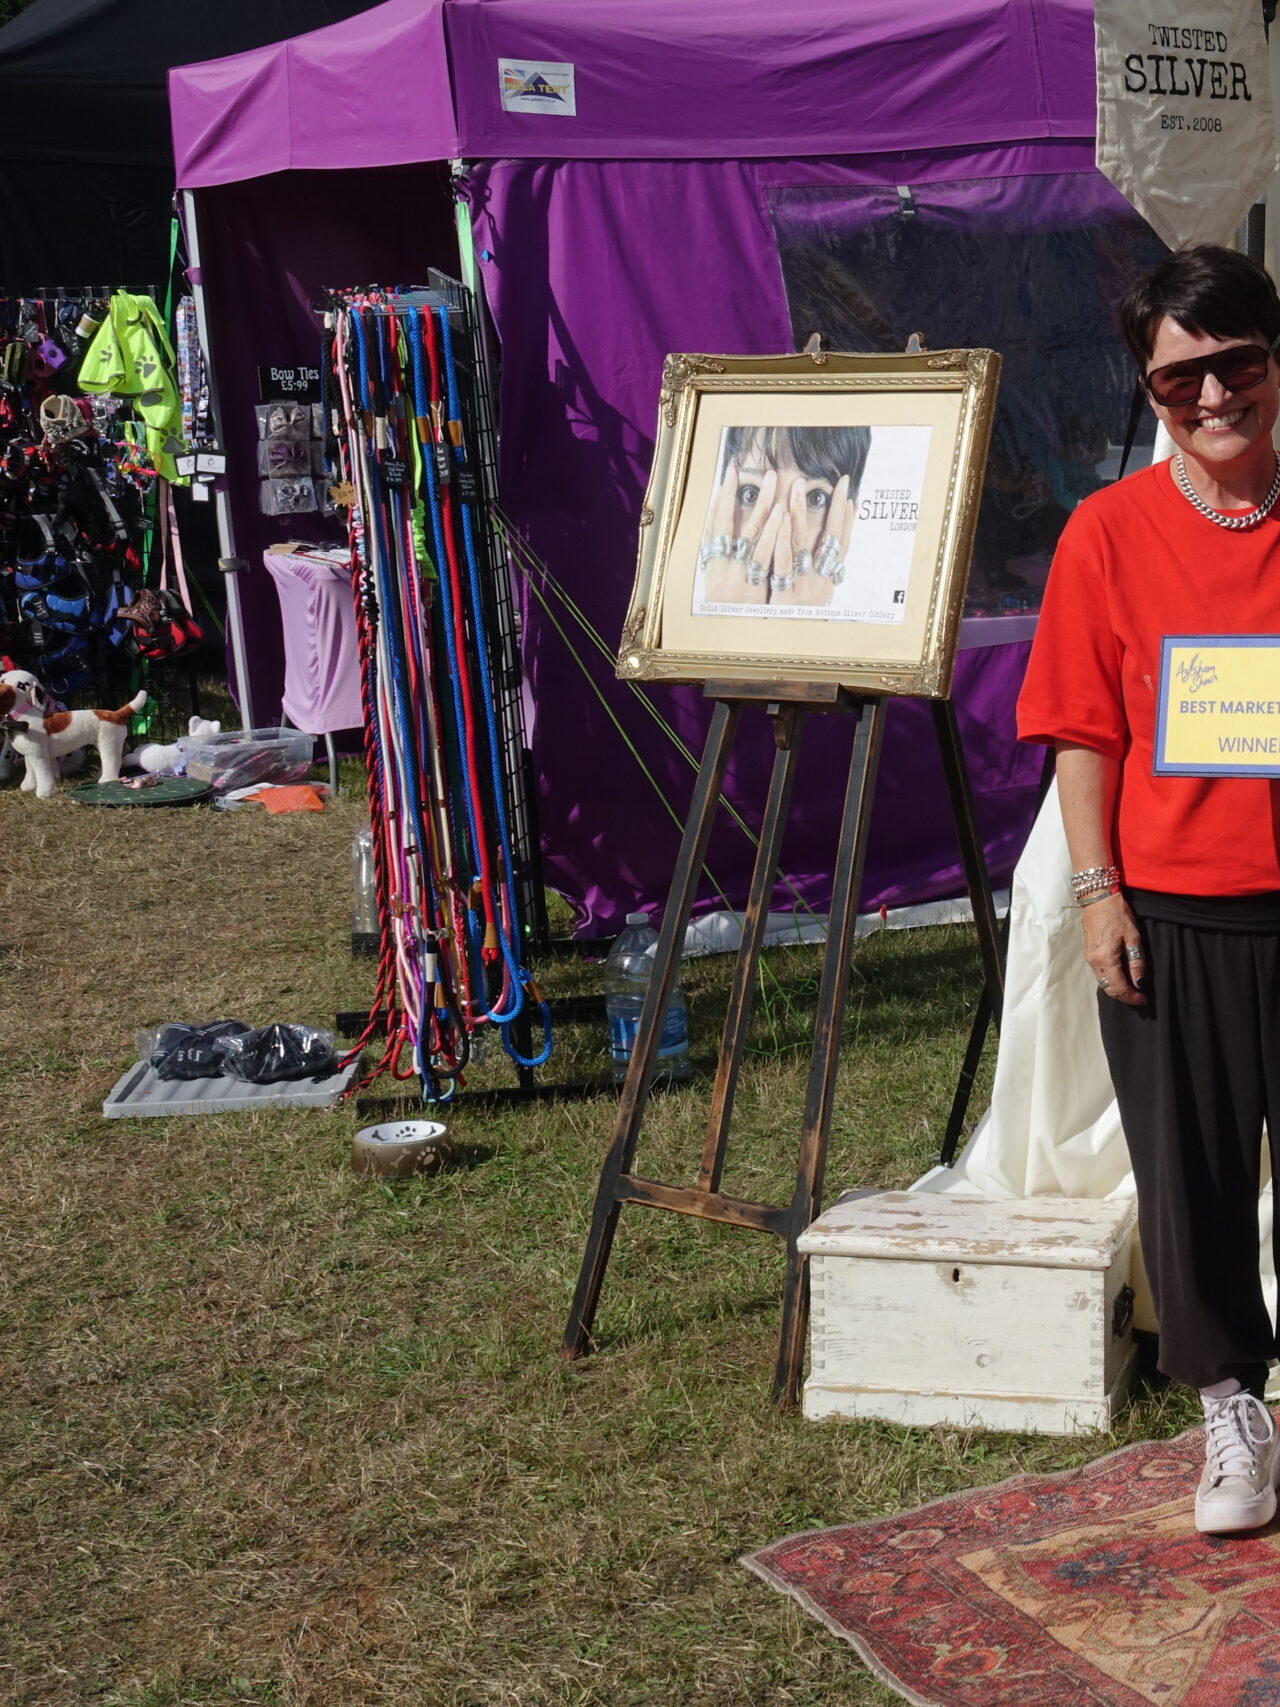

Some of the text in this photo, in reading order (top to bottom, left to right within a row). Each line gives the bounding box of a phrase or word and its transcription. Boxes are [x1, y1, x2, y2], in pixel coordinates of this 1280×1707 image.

[1148, 23, 1228, 53] TWISTED
[1124, 54, 1252, 102] SILVER
[1161, 114, 1222, 132] EST.2008
[270, 367, 295, 381] Bow
[874, 489, 912, 500] TWISTED
[859, 499, 919, 520] SILVER
[1179, 700, 1216, 714] BEST
